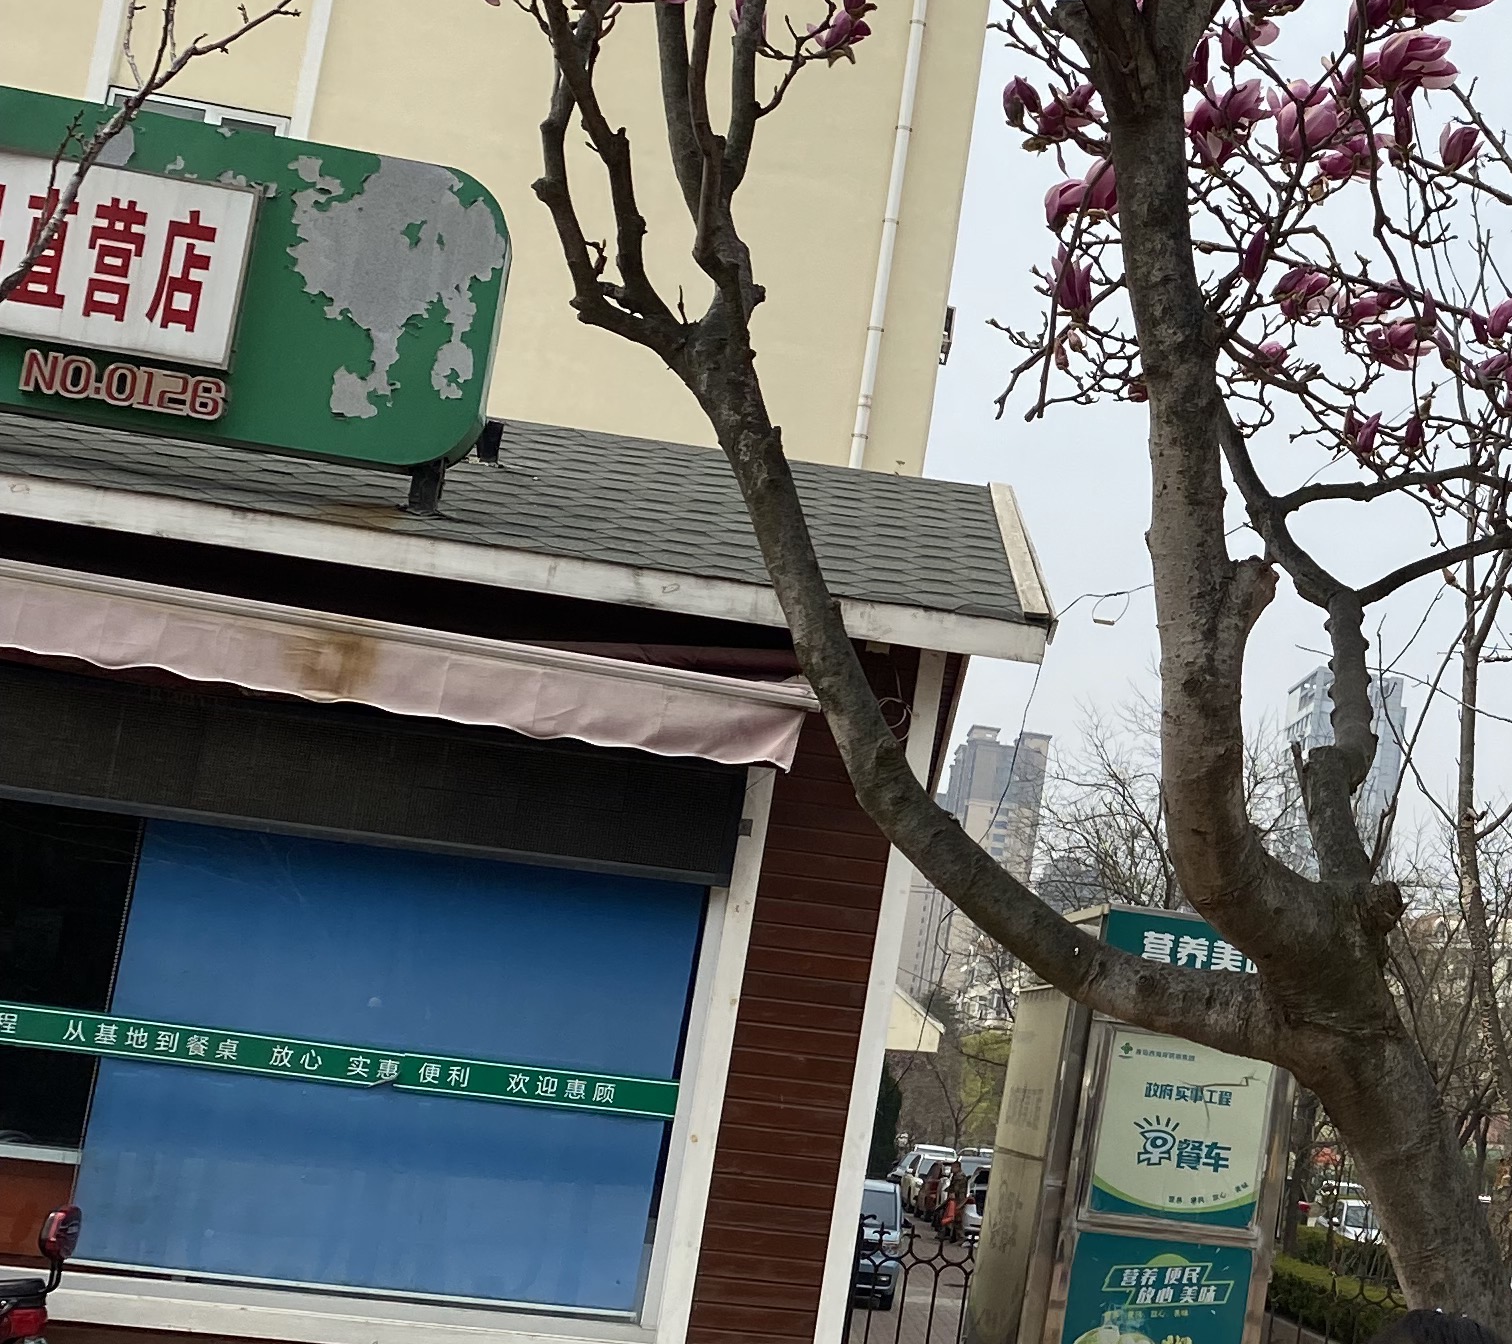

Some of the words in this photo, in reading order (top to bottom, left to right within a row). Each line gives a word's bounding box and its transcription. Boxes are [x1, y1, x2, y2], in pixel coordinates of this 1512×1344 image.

[0, 184, 217, 333] 直营店
[22, 351, 224, 419] NO.0126
[1141, 931, 1258, 974] 营养美
[63, 1019, 240, 1061] 从基地到餐桌
[269, 1045, 322, 1071] 放心
[346, 1056, 400, 1080] 实惠
[418, 1062, 471, 1087] 便利
[506, 1073, 617, 1103] 欢迎惠顾
[1137, 1129, 1231, 1173] 早餐车
[1120, 1268, 1159, 1286] 营养
[1163, 1266, 1201, 1285] 便民
[1136, 1286, 1174, 1304] 放心
[1180, 1285, 1217, 1303] 美味
